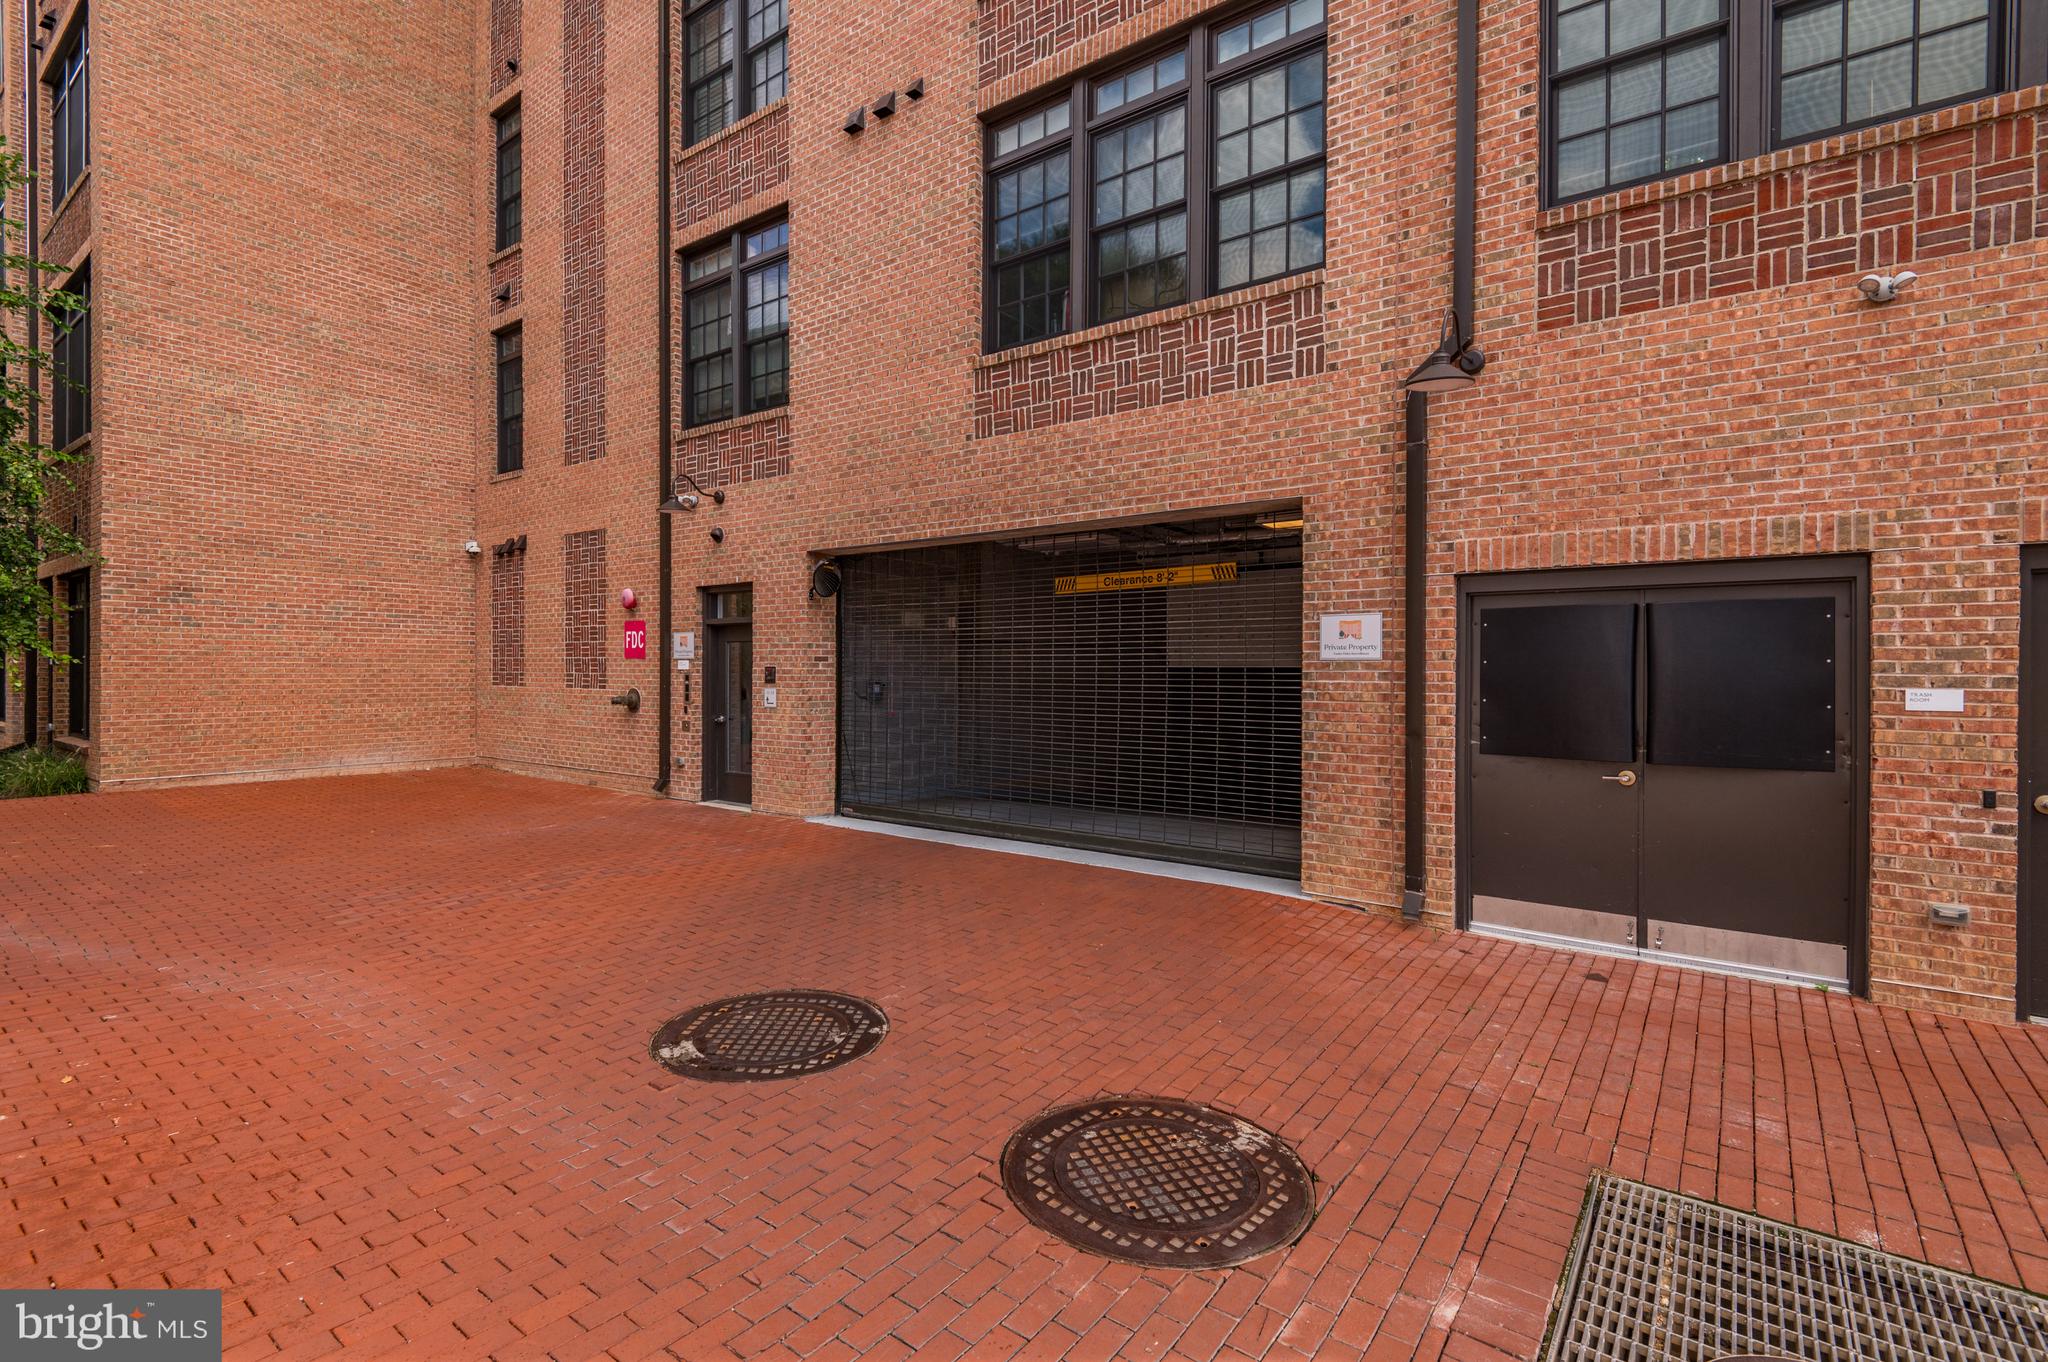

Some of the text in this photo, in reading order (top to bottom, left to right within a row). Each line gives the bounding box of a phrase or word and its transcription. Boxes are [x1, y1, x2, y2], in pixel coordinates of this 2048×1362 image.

[1103, 575, 1154, 587] Clearance
[625, 630, 644, 649] FDC
[1348, 643, 1377, 652] Property
